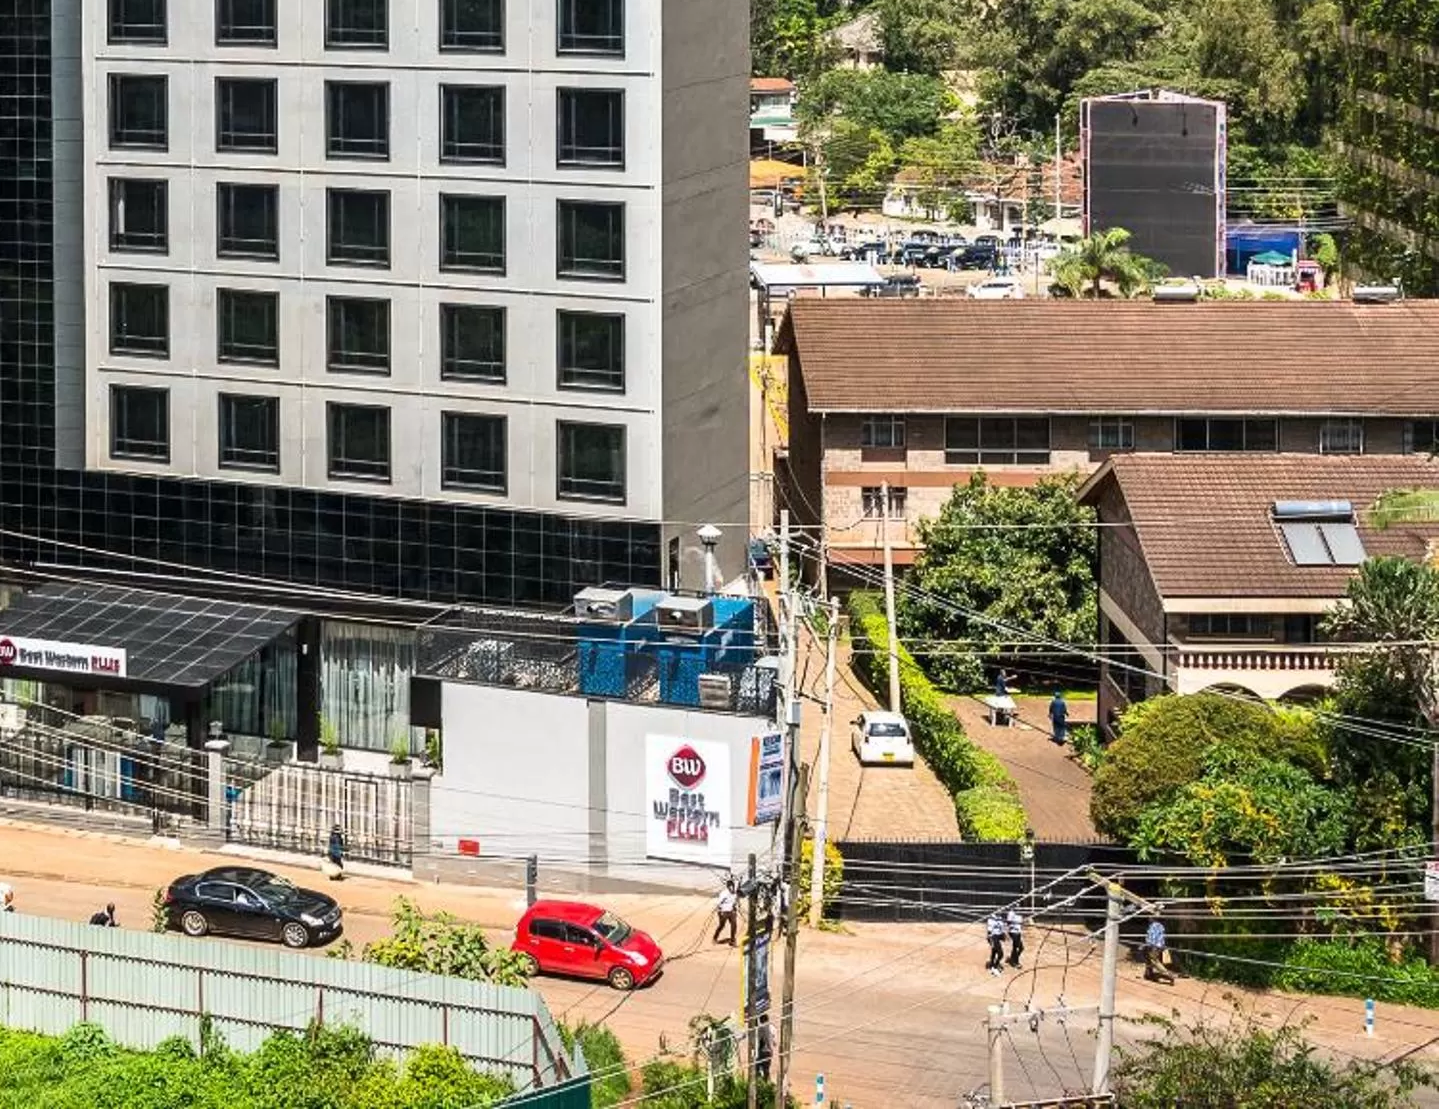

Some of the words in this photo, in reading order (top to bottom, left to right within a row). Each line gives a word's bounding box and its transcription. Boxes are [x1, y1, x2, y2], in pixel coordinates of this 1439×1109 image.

[672, 756, 701, 776] BW
[669, 788, 704, 806] Best
[653, 801, 720, 828] Western
